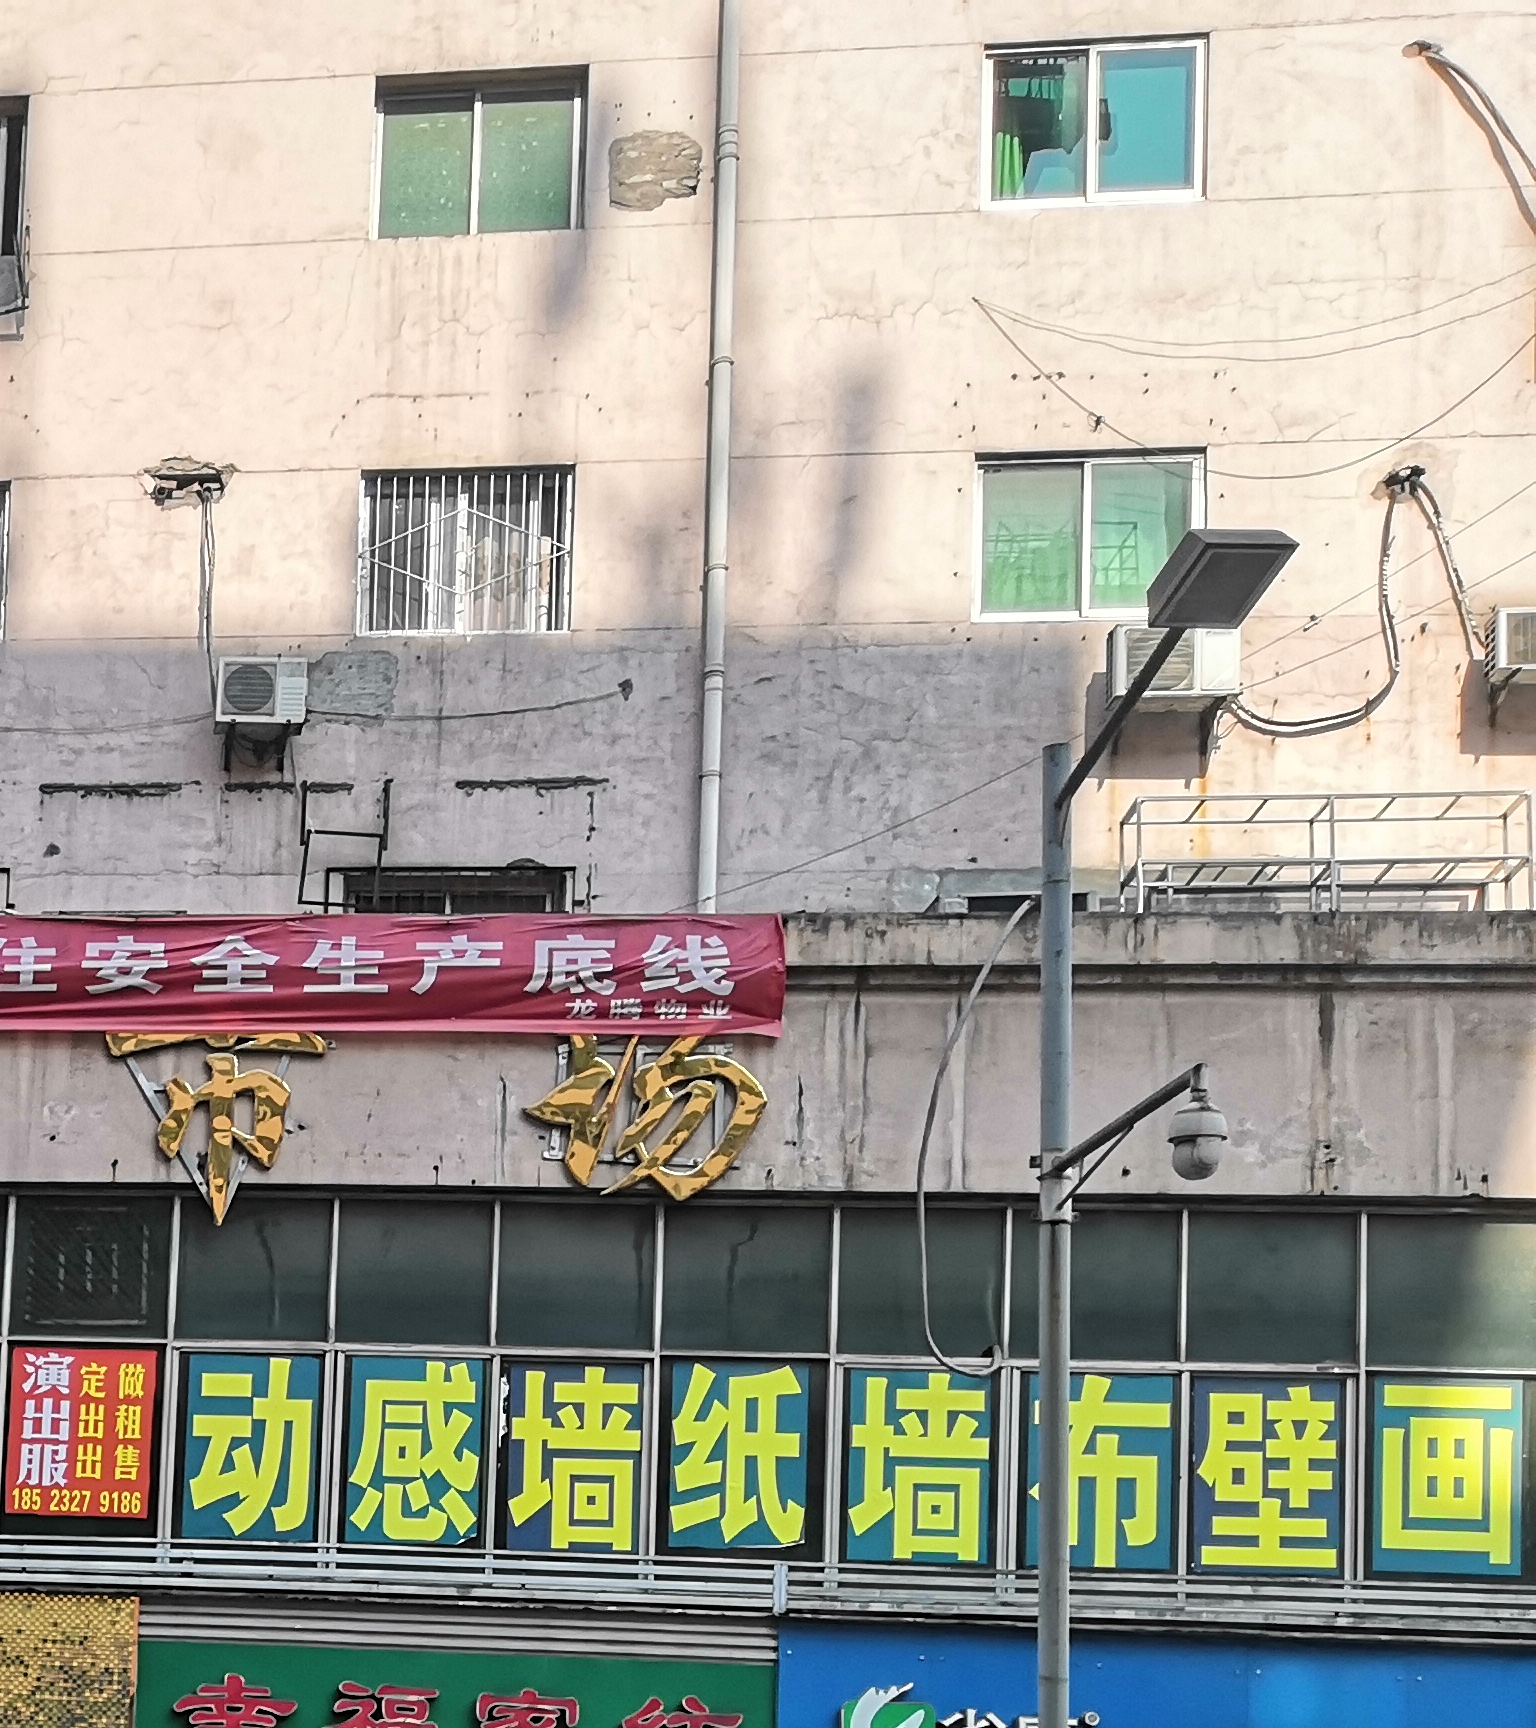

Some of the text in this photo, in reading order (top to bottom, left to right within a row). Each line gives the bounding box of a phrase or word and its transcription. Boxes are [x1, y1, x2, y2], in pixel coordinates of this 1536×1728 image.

[566, 997, 734, 1022] 龙腾物业
[15, 1351, 76, 1488] 演出服
[12, 1487, 142, 1514] 185 2327 9186
[188, 1357, 1514, 1569] 动感墙纸墙布壁画
